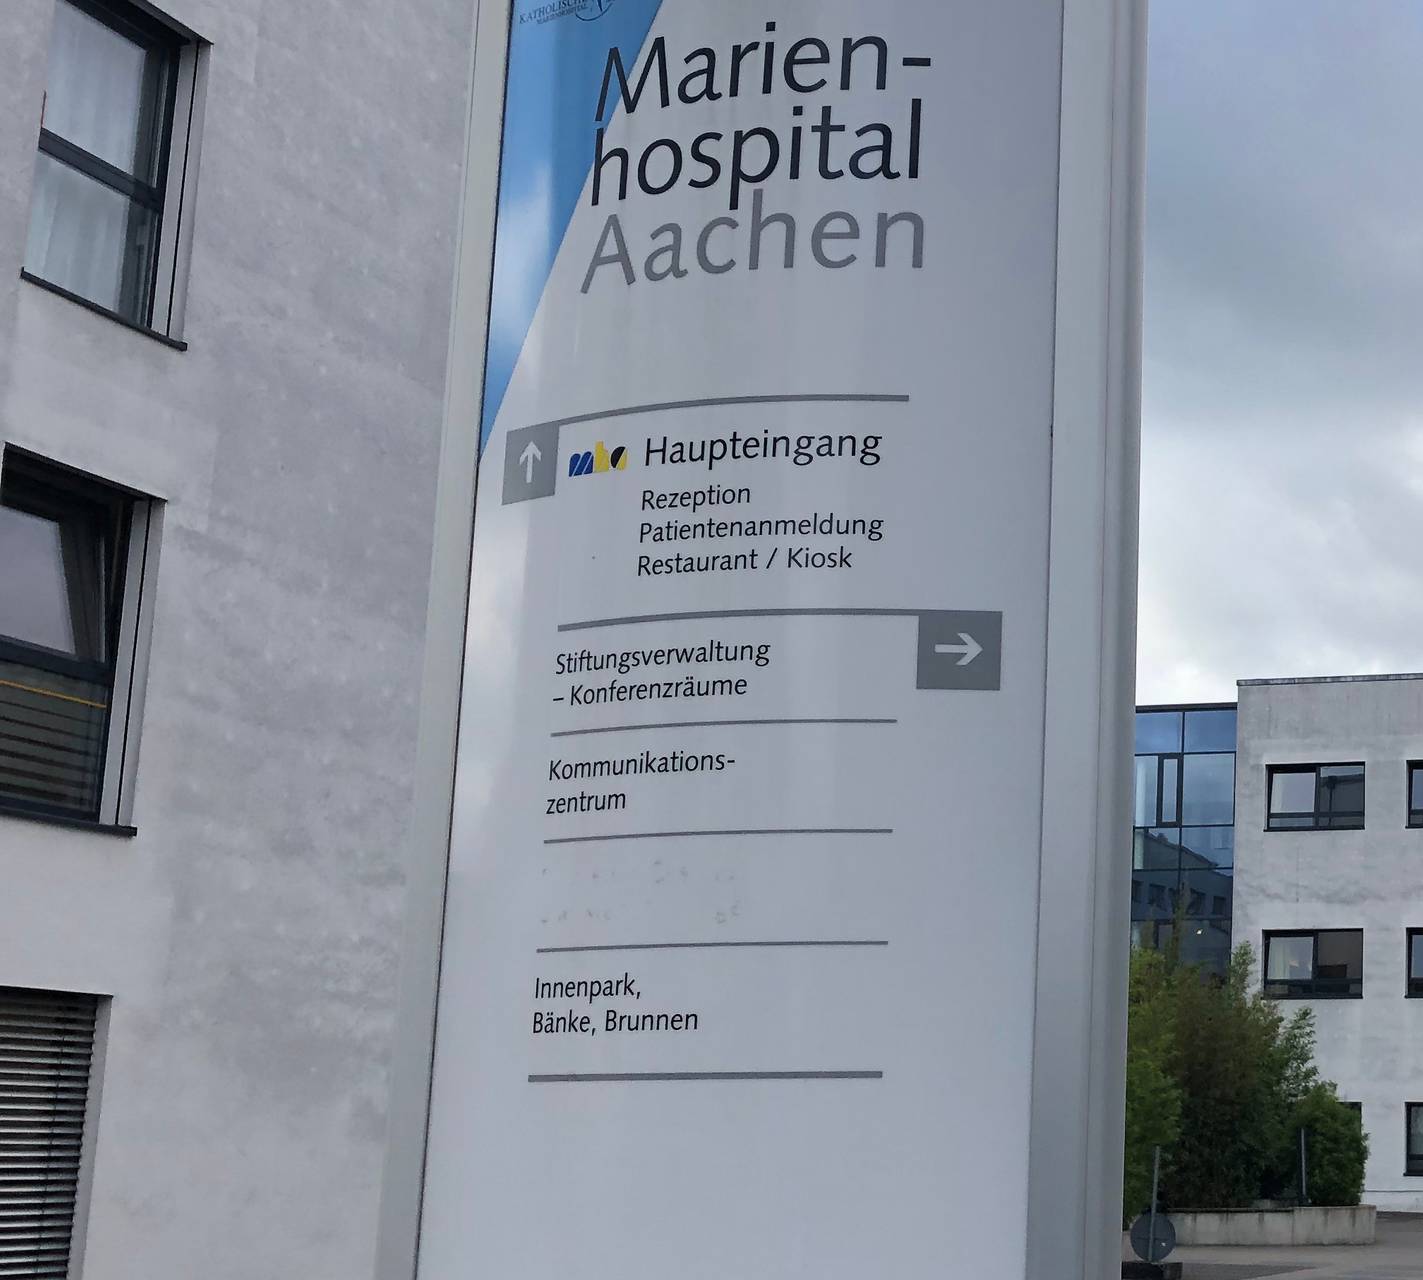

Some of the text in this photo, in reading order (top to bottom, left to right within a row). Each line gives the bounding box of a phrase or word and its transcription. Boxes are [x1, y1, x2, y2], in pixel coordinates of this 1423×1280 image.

[595, 21, 932, 122] Marien-
[590, 98, 923, 211] hospital
[580, 188, 925, 295] Aachen
[644, 428, 883, 471] Haupteingang
[641, 483, 751, 514] Rezeption
[639, 512, 885, 544] Patientenanmeldung
[637, 545, 853, 577] Restaurant / Kiosk
[555, 639, 772, 675] Stiftungsverwaltung
[570, 675, 748, 707] Konferenzräume
[548, 750, 736, 782] Kommunikations-
[545, 790, 626, 815] zentrum
[534, 971, 641, 1005] Innenpark,
[532, 1008, 699, 1037] Bänke, Brunnen
